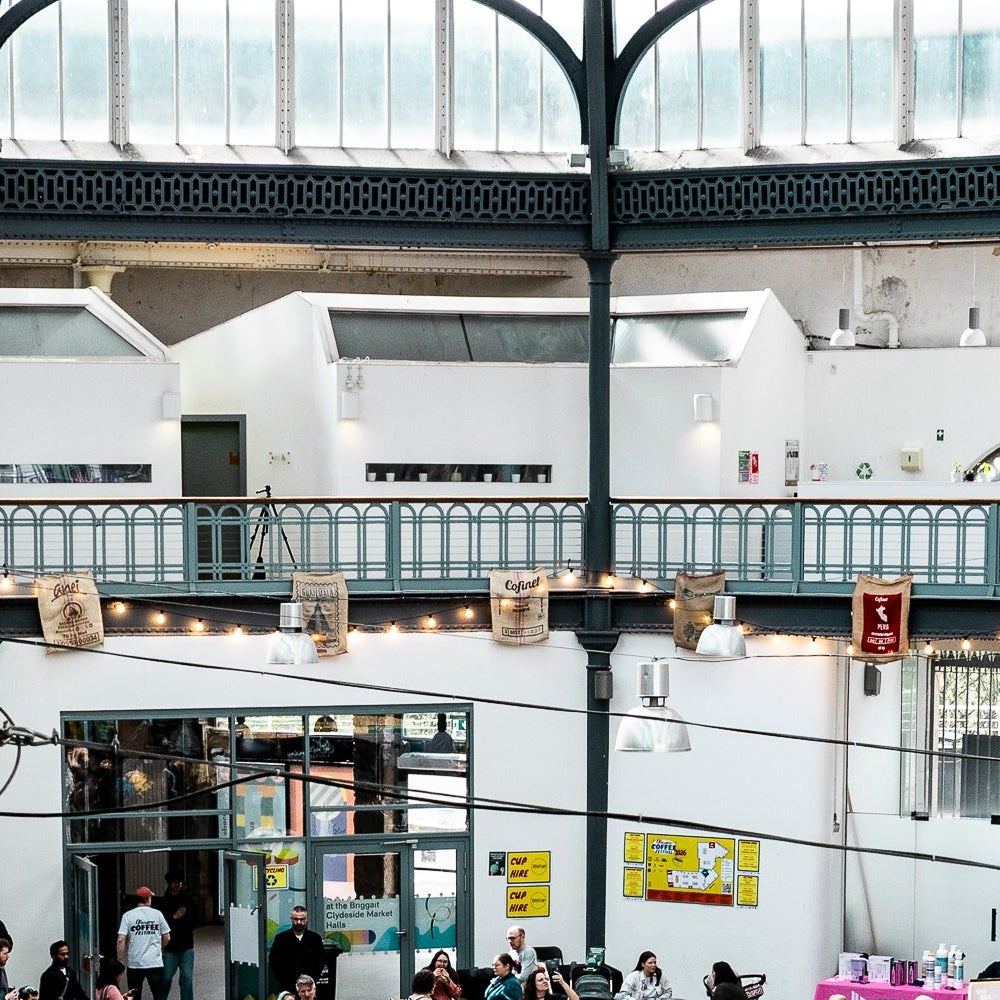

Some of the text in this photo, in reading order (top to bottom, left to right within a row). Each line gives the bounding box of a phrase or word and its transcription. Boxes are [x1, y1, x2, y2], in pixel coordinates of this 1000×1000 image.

[510, 856, 528, 866] CUP
[510, 869, 529, 878] HIRE
[509, 891, 527, 900] CUP
[350, 901, 380, 911] Briggait
[509, 903, 529, 912] HIRE
[326, 910, 393, 920] Clydeside Market
[130, 924, 160, 932] COFFEE
[326, 921, 346, 929] Halls
